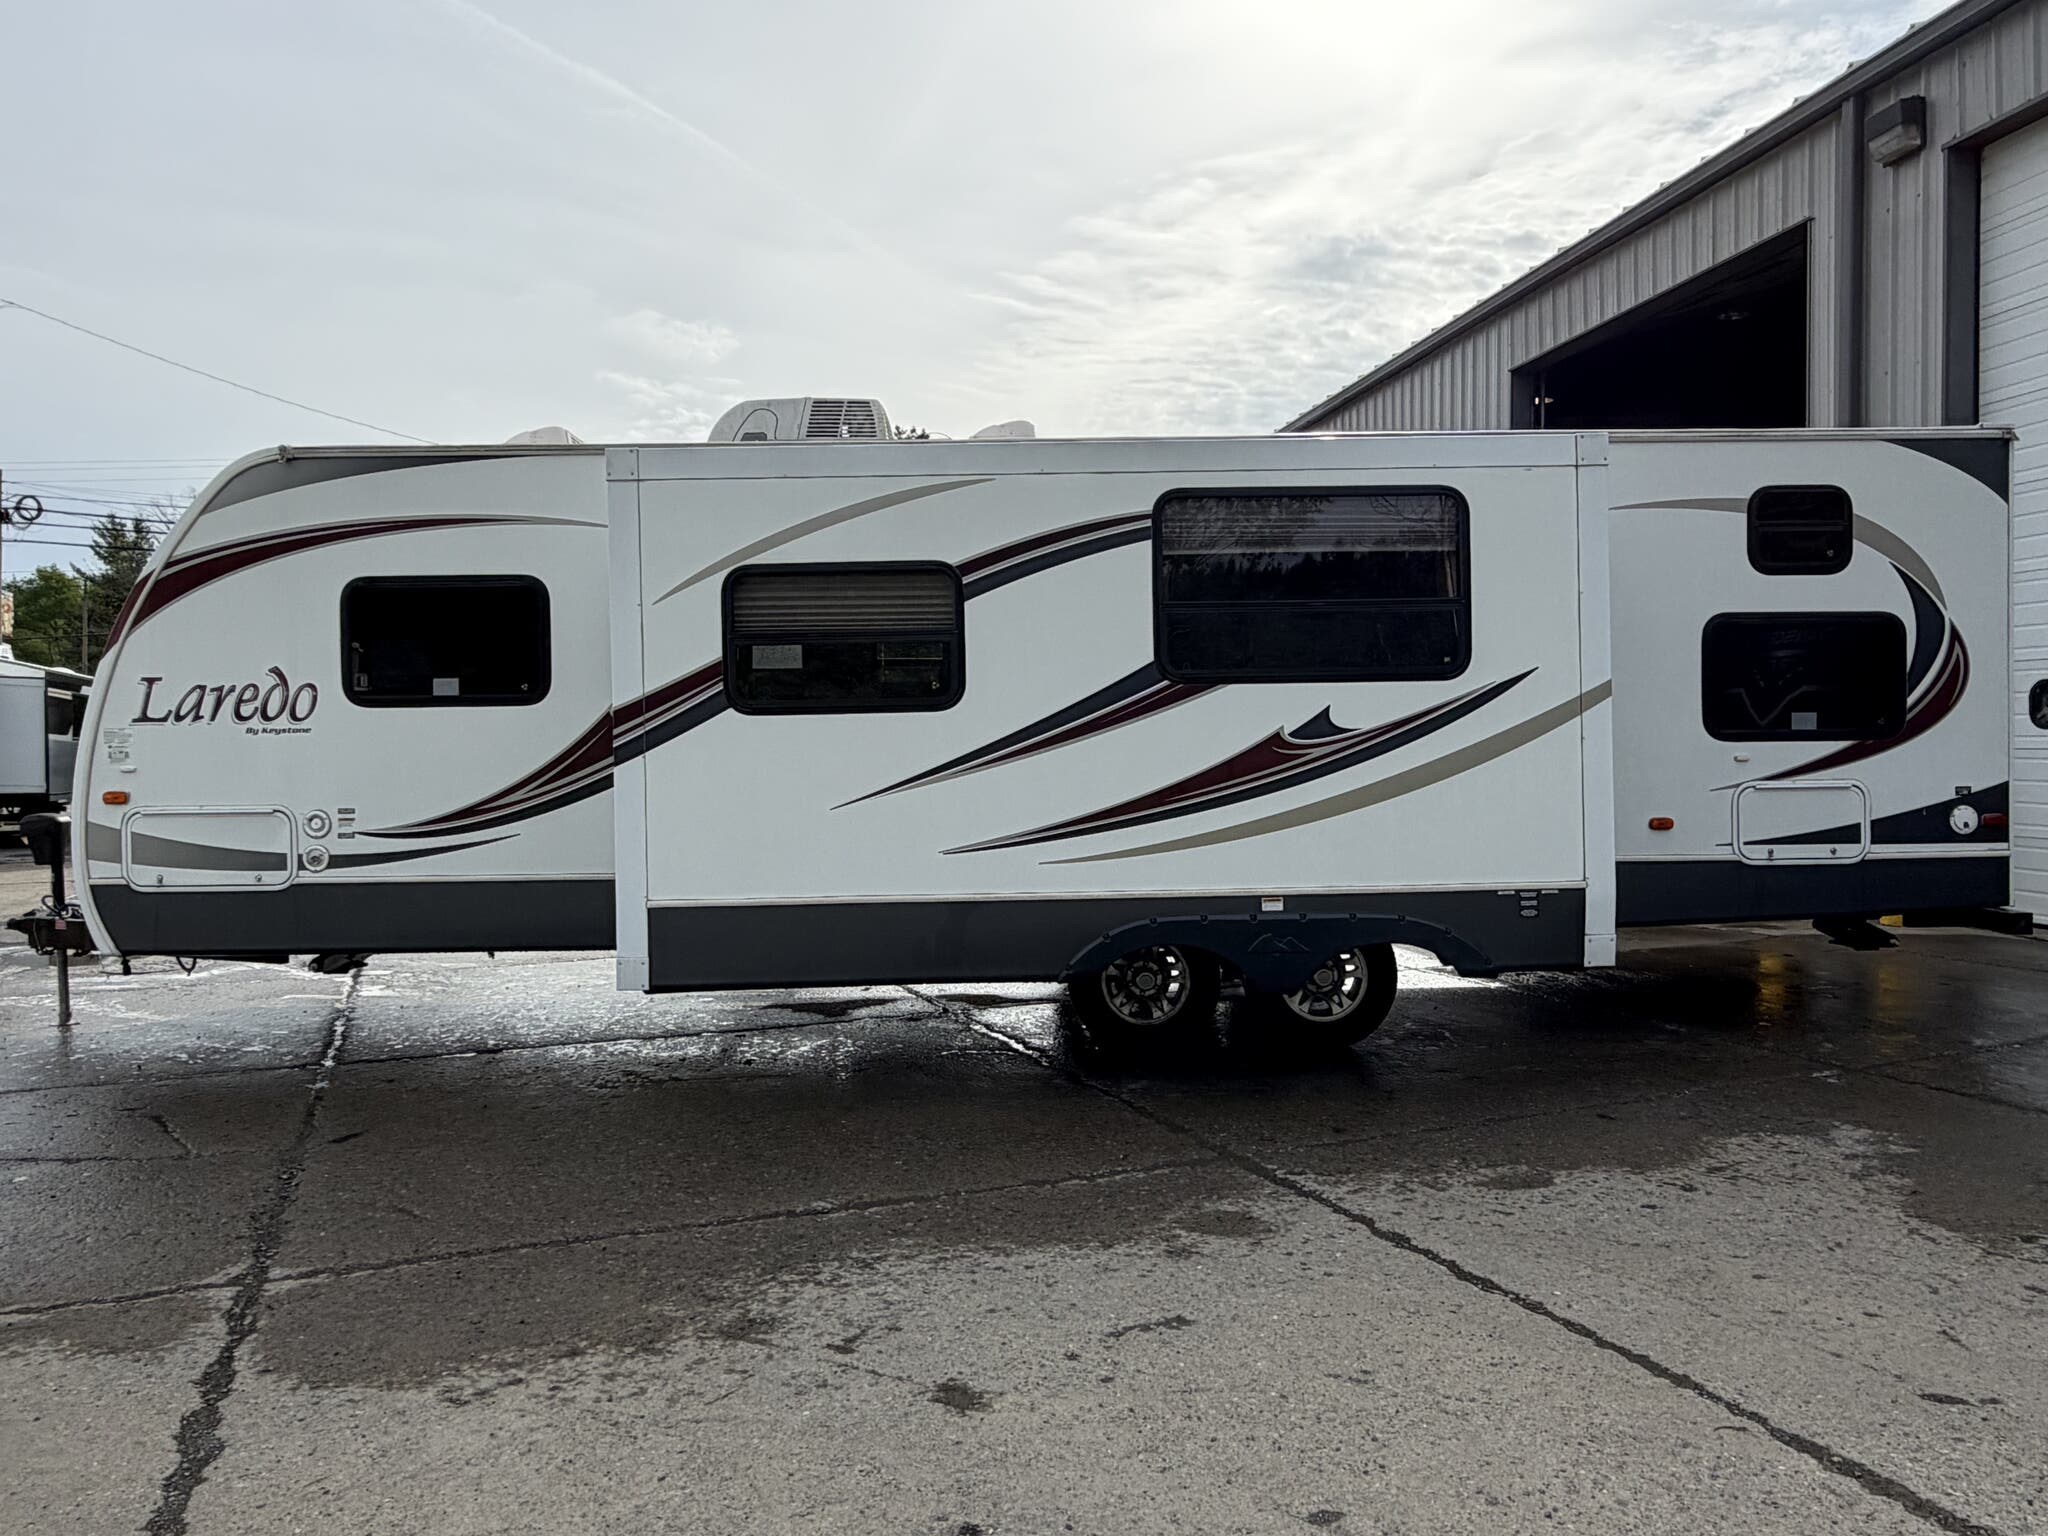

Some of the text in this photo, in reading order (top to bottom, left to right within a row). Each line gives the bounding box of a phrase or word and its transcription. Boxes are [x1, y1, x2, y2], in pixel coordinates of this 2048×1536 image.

[129, 666, 319, 726] Laredo
[245, 727, 312, 736] By Keystone
